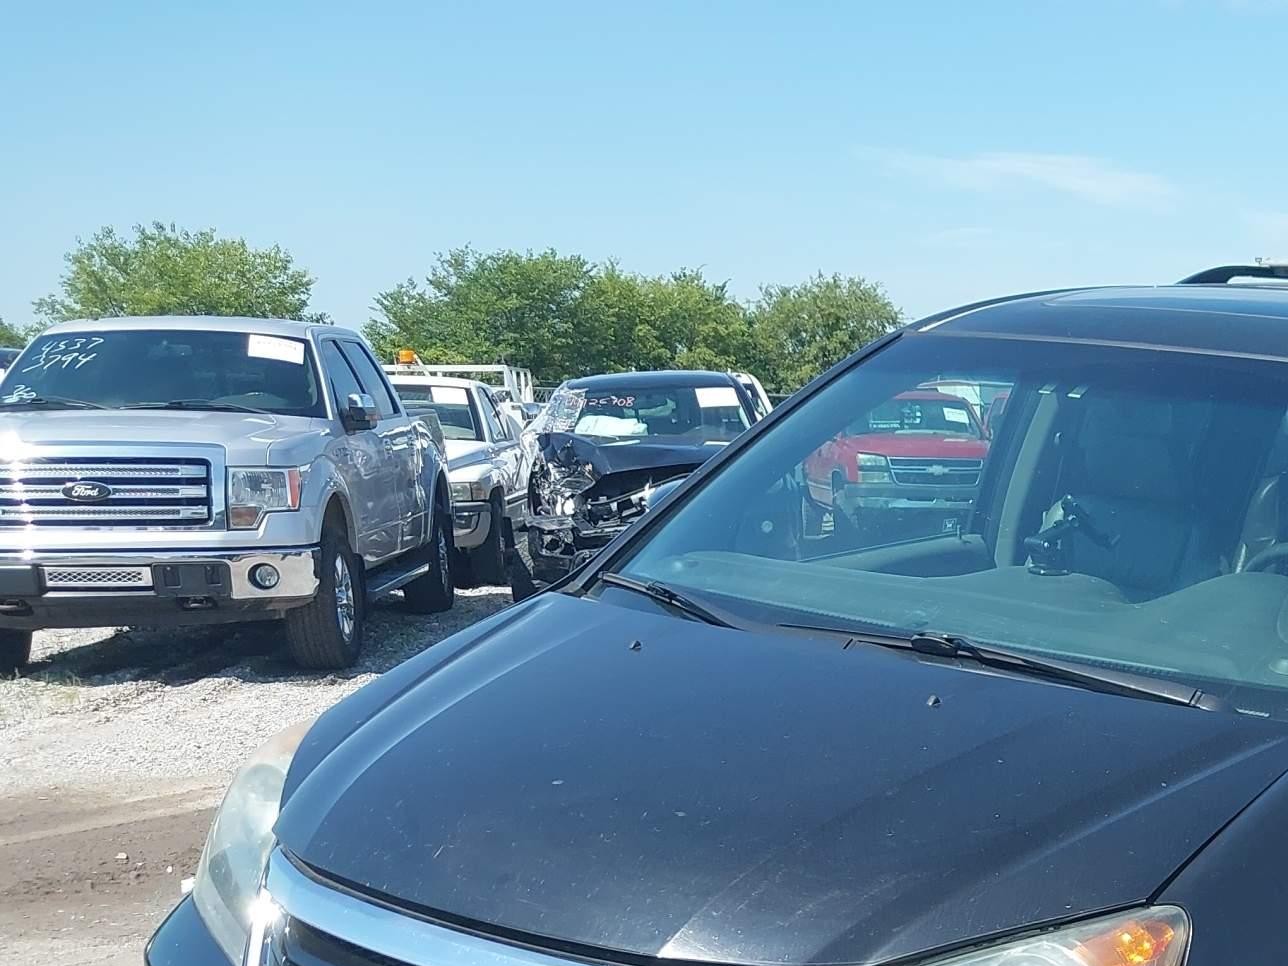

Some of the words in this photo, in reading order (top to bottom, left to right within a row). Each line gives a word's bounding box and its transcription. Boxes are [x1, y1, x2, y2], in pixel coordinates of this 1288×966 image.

[41, 337, 105, 355] 4537
[22, 352, 97, 372] 3794
[71, 484, 99, 497] Ford
